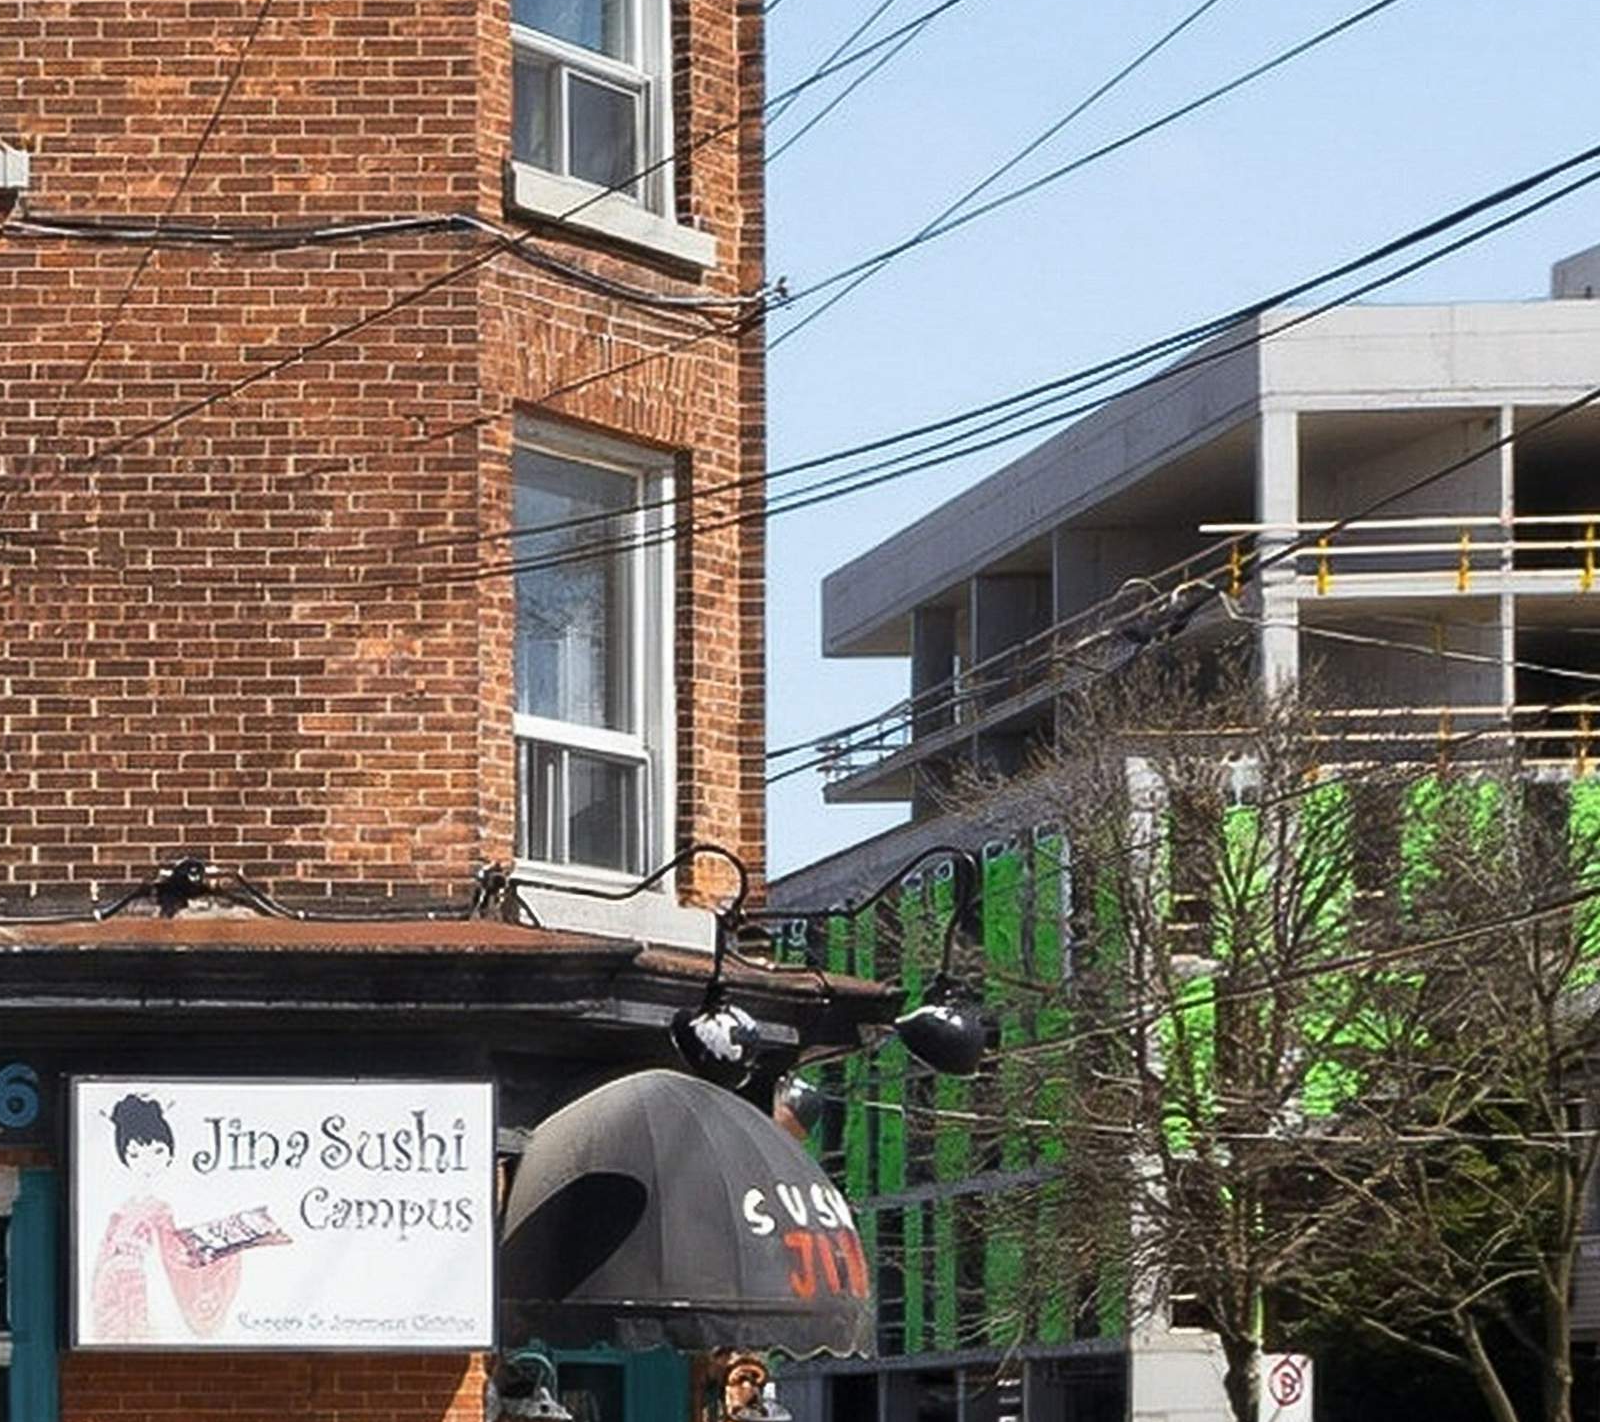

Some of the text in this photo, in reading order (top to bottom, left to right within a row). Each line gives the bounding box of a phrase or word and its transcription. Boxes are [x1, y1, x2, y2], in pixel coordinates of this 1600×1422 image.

[192, 1109, 468, 1175] Jina Sushi
[300, 1185, 474, 1242] Campus
